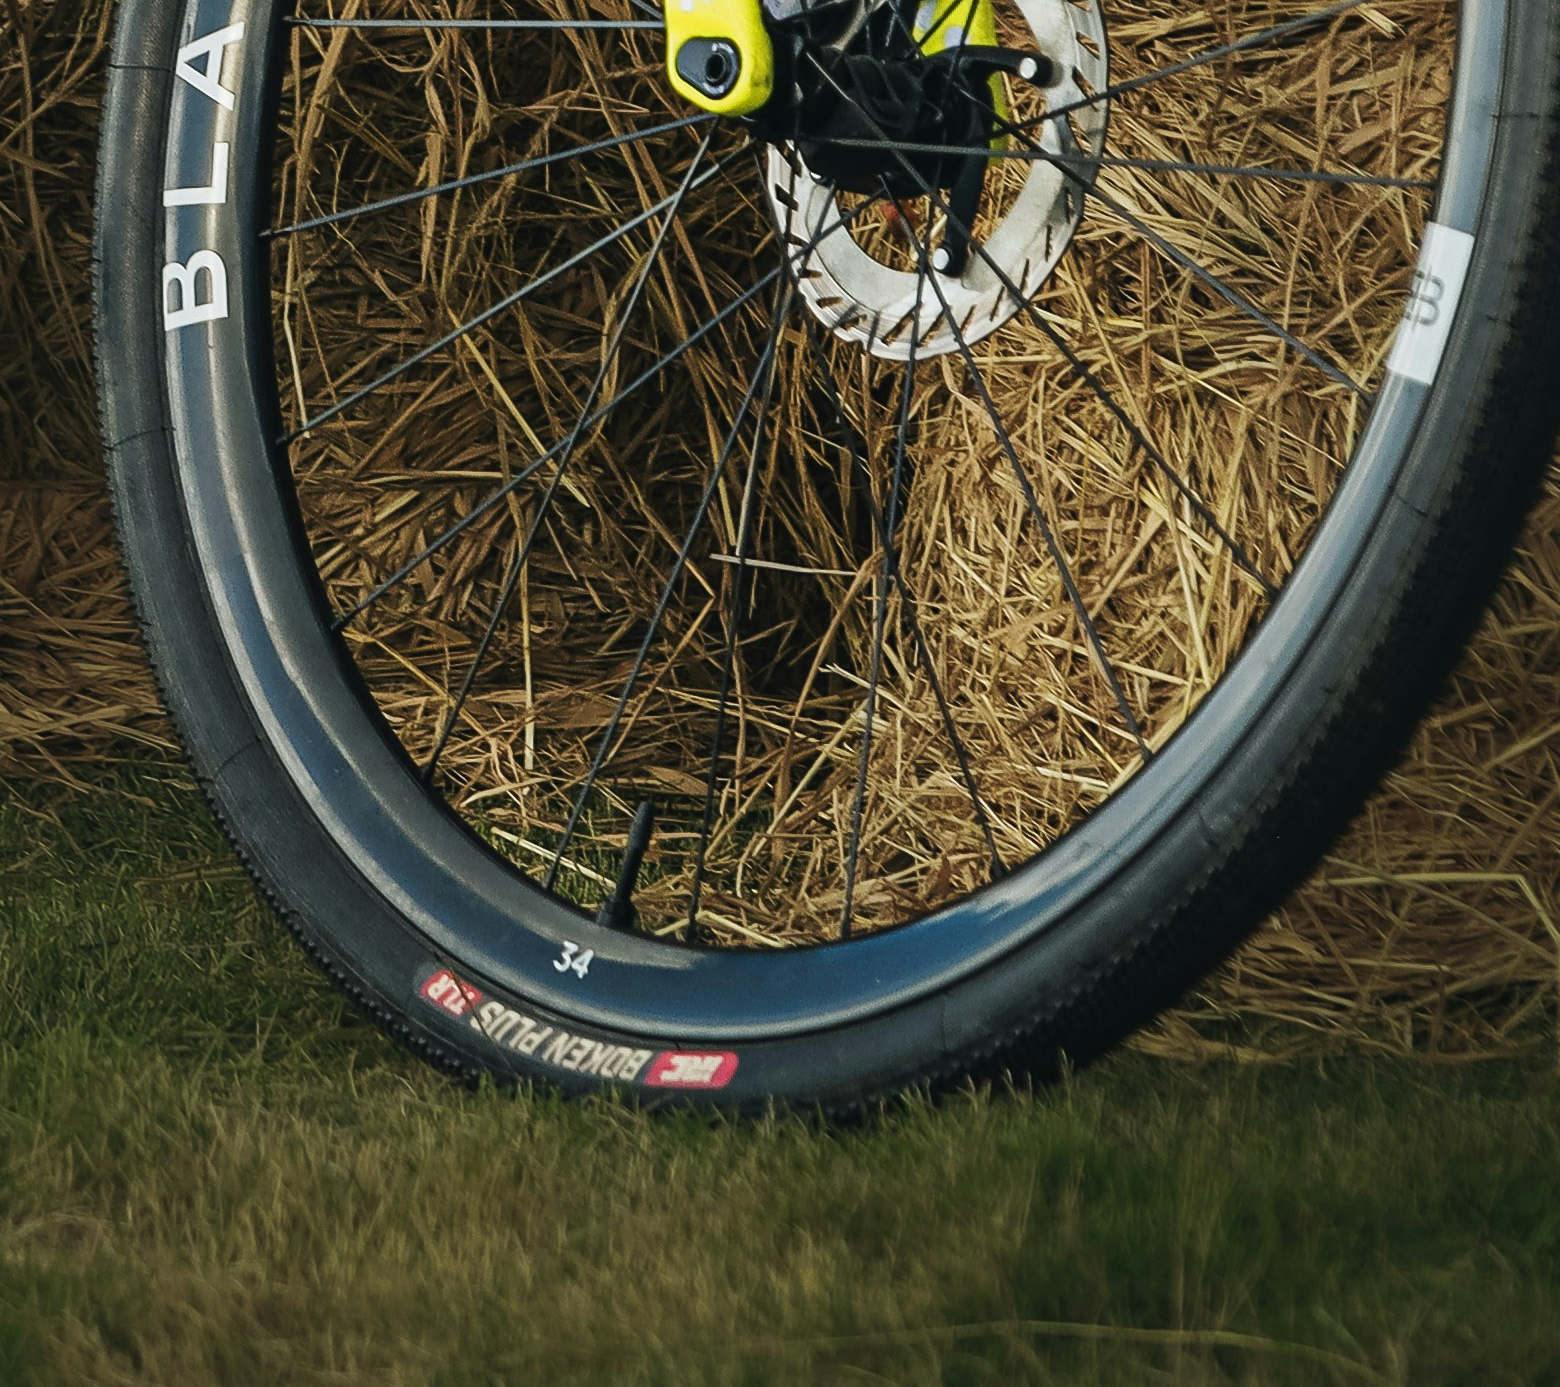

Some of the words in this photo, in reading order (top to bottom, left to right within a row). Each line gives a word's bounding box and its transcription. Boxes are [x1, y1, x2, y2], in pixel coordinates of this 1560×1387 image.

[553, 940, 594, 979] 34
[426, 973, 476, 1016] TLR
[469, 1000, 554, 1056] PLUS
[541, 1031, 654, 1081] BOKEN
